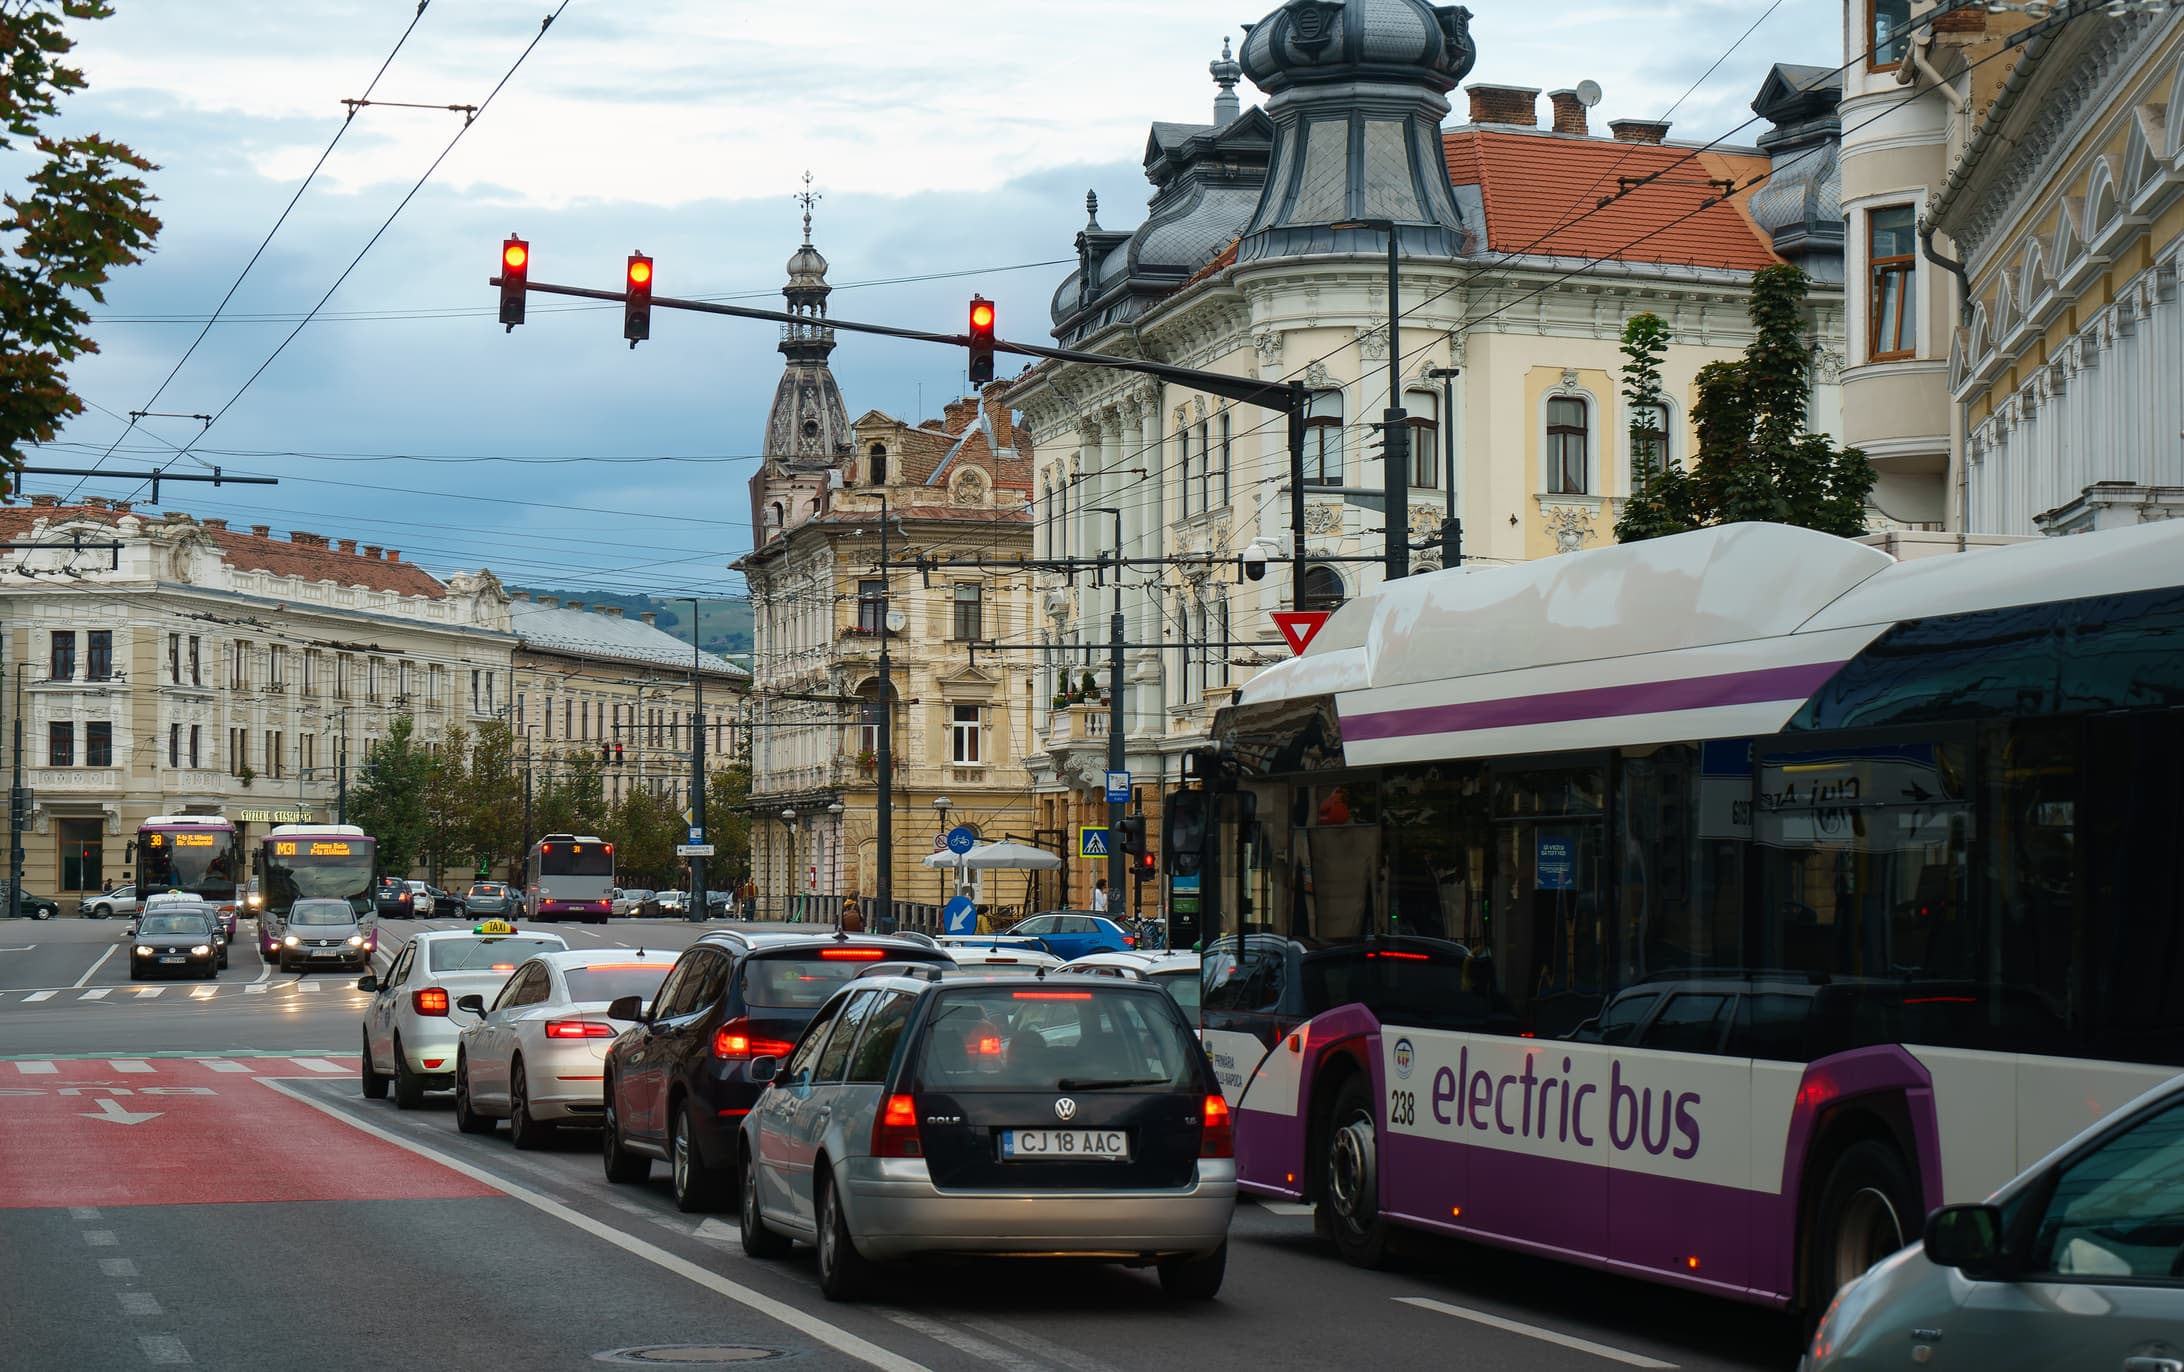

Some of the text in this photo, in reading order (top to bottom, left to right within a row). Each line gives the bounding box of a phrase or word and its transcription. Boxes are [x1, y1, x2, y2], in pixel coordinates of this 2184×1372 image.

[150, 834, 162, 846] 38
[277, 842, 296, 855] M31
[488, 921, 506, 932] TAXI
[1391, 1089, 1415, 1126] 238
[1432, 1046, 1702, 1161] electric bus
[926, 1116, 961, 1125] GOLF
[1021, 1132, 1121, 1153] CJ 18 AAC
